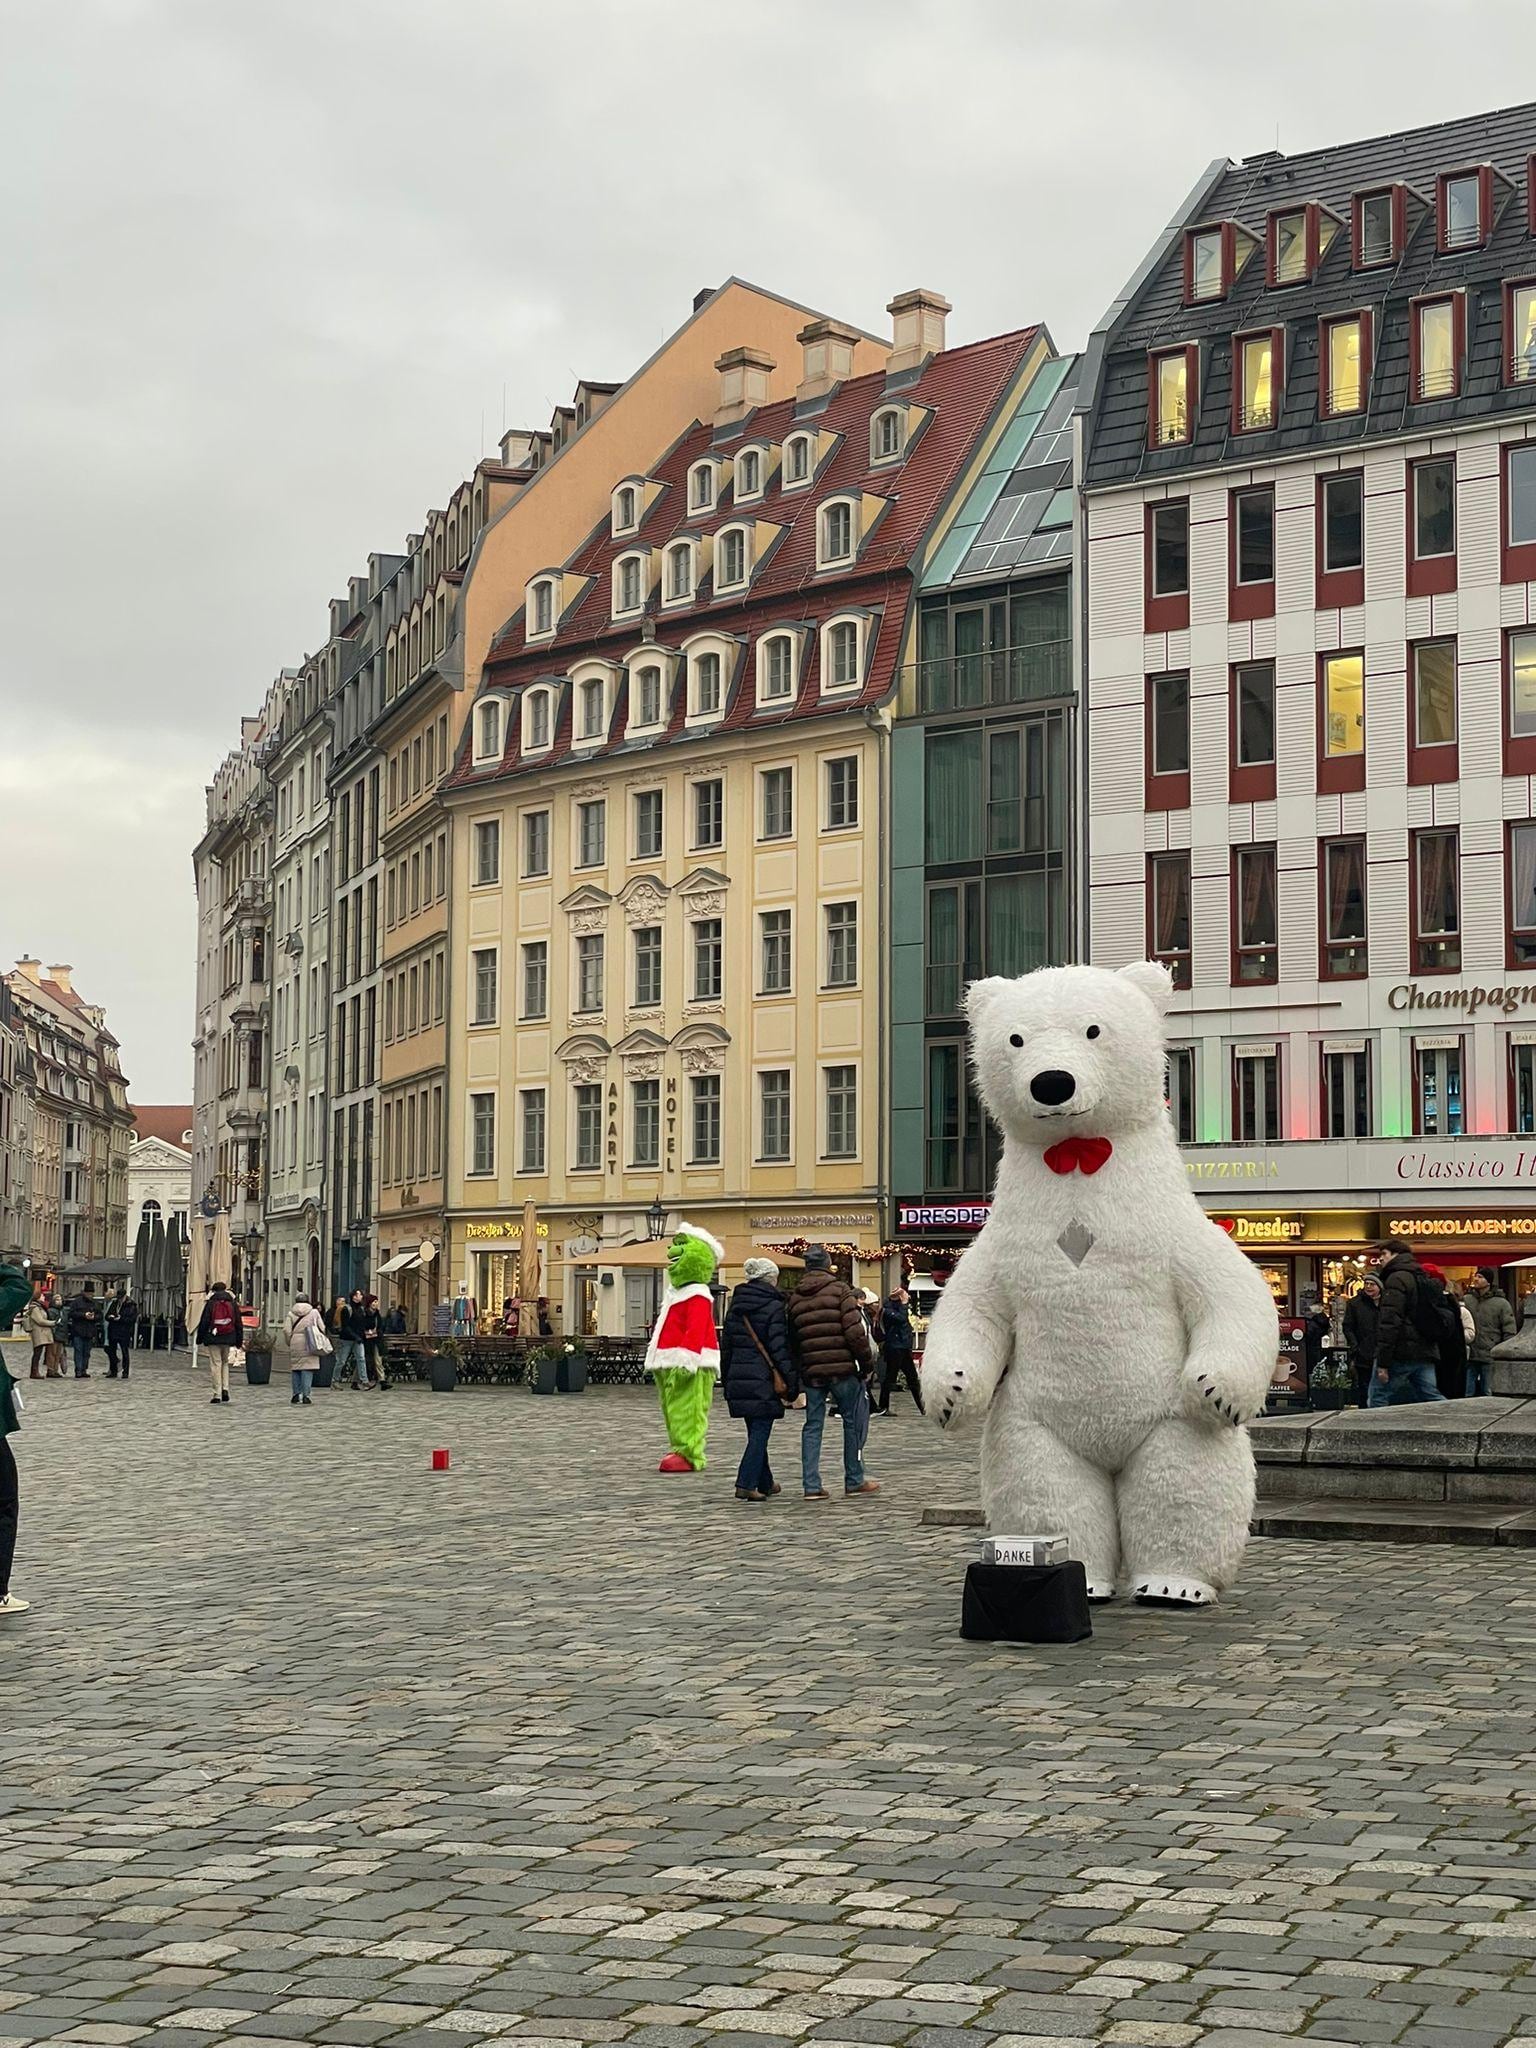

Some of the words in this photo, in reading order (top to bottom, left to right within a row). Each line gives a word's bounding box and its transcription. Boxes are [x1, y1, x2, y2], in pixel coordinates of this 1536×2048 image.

[1387, 983, 1536, 1015] Champagn
[608, 1082, 618, 1175] APART
[666, 1078, 676, 1173] HOTEL
[1185, 1161, 1280, 1178] PIZZERIA
[1397, 1153, 1505, 1179] Classico
[466, 1223, 503, 1238] Dresden
[1237, 1216, 1301, 1237] Dresden
[1389, 1219, 1536, 1235] SCHOKOLADEN-KO
[995, 1549, 1031, 1563] DANKE
